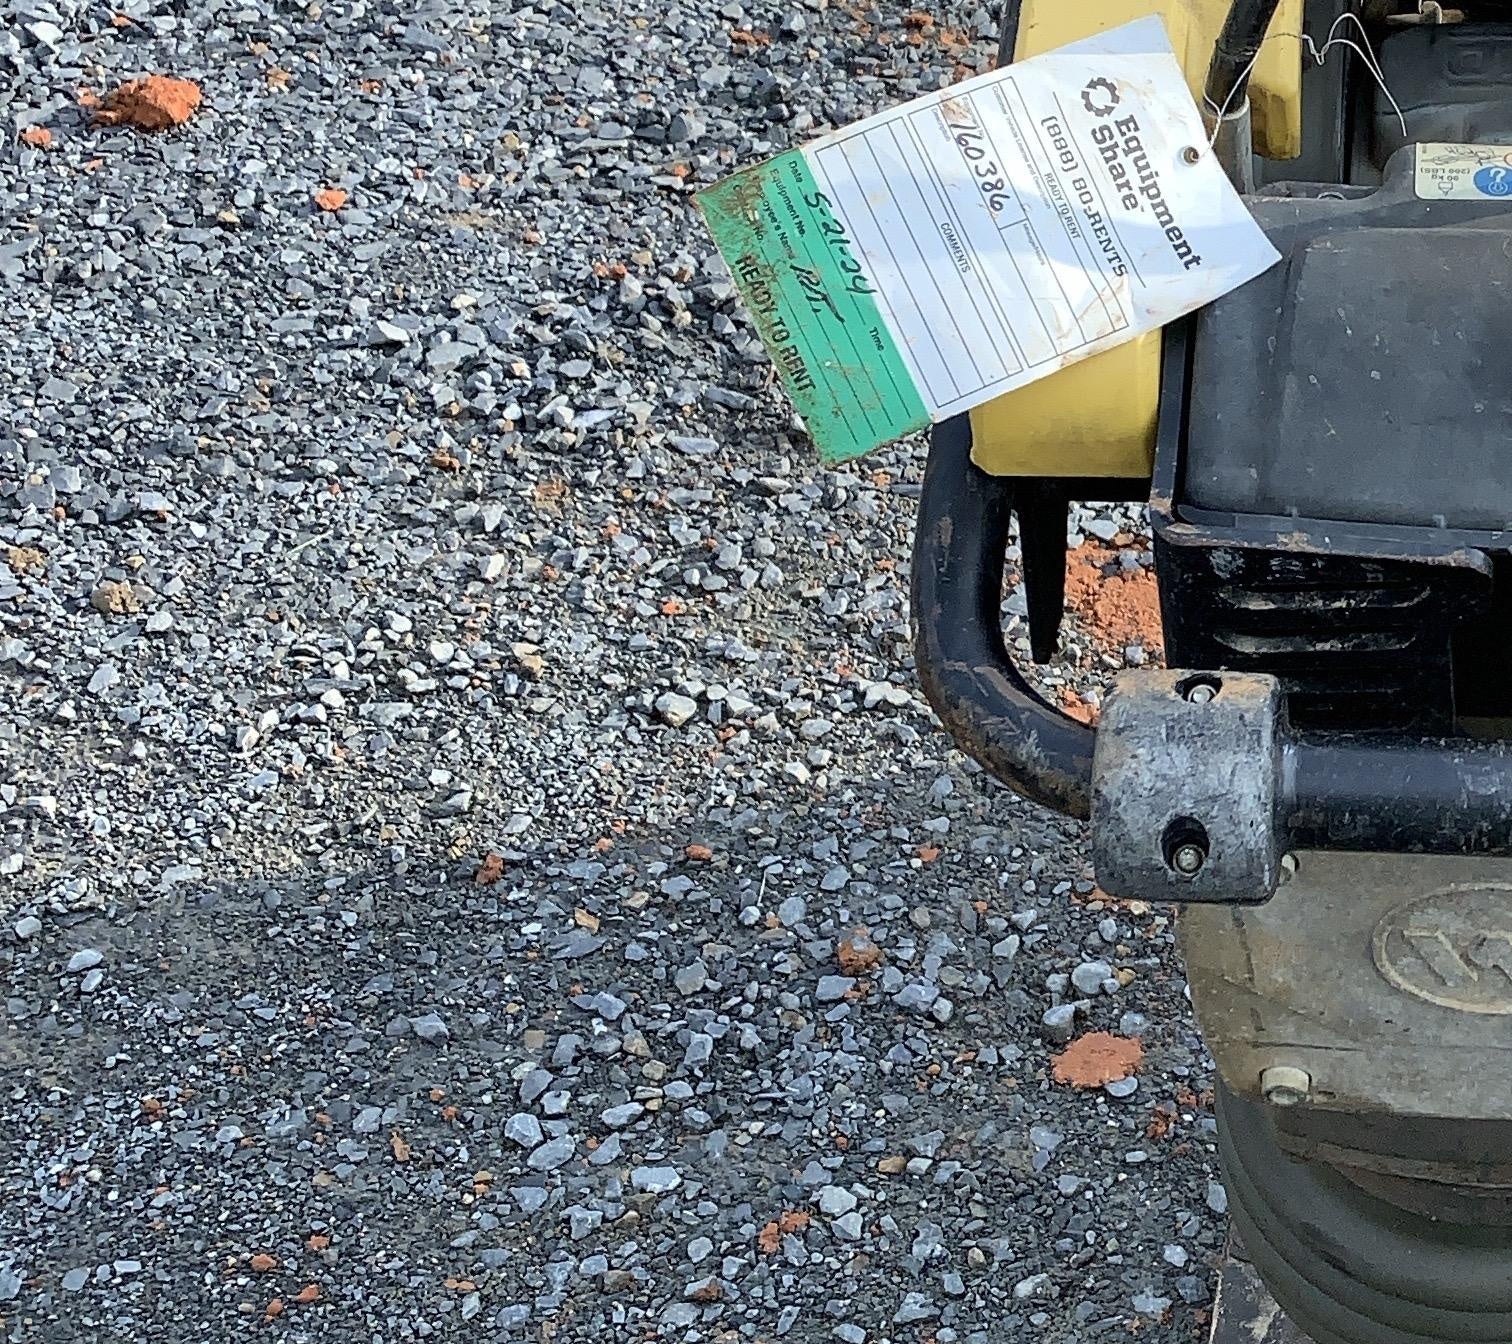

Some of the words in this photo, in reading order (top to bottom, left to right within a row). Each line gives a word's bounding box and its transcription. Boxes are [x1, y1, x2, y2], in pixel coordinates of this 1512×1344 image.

[948, 119, 1009, 213] 160386
[1040, 115, 1078, 172] (888)
[1072, 177, 1128, 276] 80-RENTS
[1043, 172, 1064, 200] READY
[1058, 202, 1069, 215] TO
[1090, 124, 1141, 210] Share
[1110, 115, 1200, 269] Equipment
[788, 160, 803, 183] Date
[868, 326, 884, 351] Time
[803, 191, 876, 302] 5-21-24
[940, 222, 970, 273] COMMENTS
[1063, 215, 1081, 238] RENT
[734, 255, 778, 316] READY
[767, 316, 790, 343] TO
[779, 344, 816, 391] RENT
